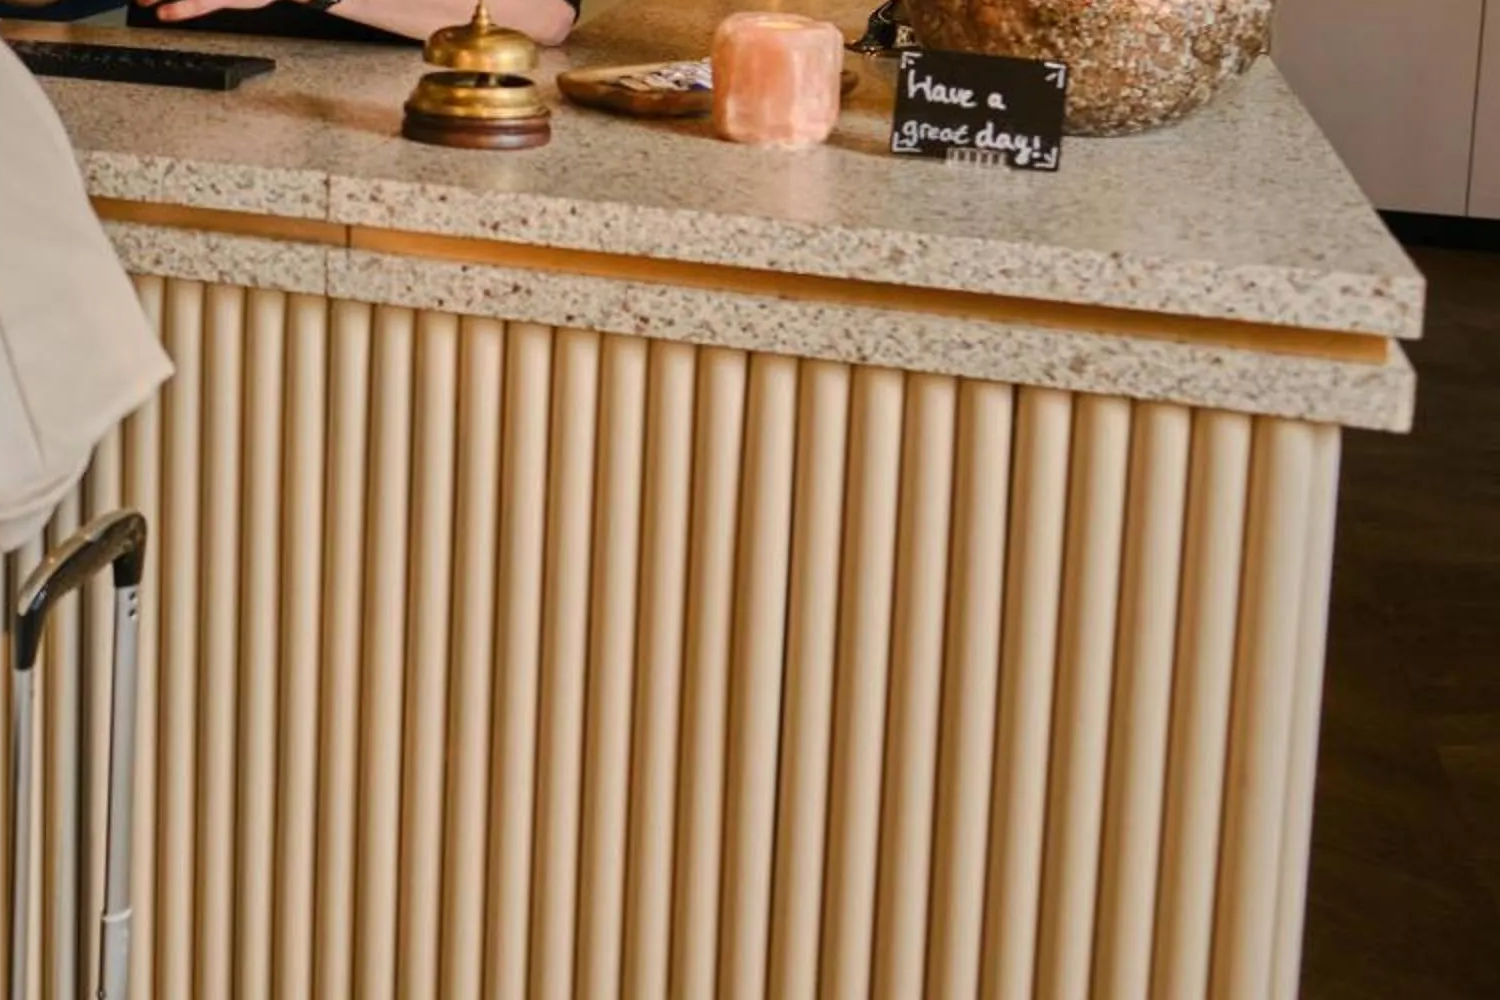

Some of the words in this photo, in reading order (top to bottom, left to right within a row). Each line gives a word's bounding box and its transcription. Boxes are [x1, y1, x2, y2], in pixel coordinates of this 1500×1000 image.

[907, 69, 977, 108] Have
[987, 92, 1007, 111] a
[902, 120, 971, 147] great
